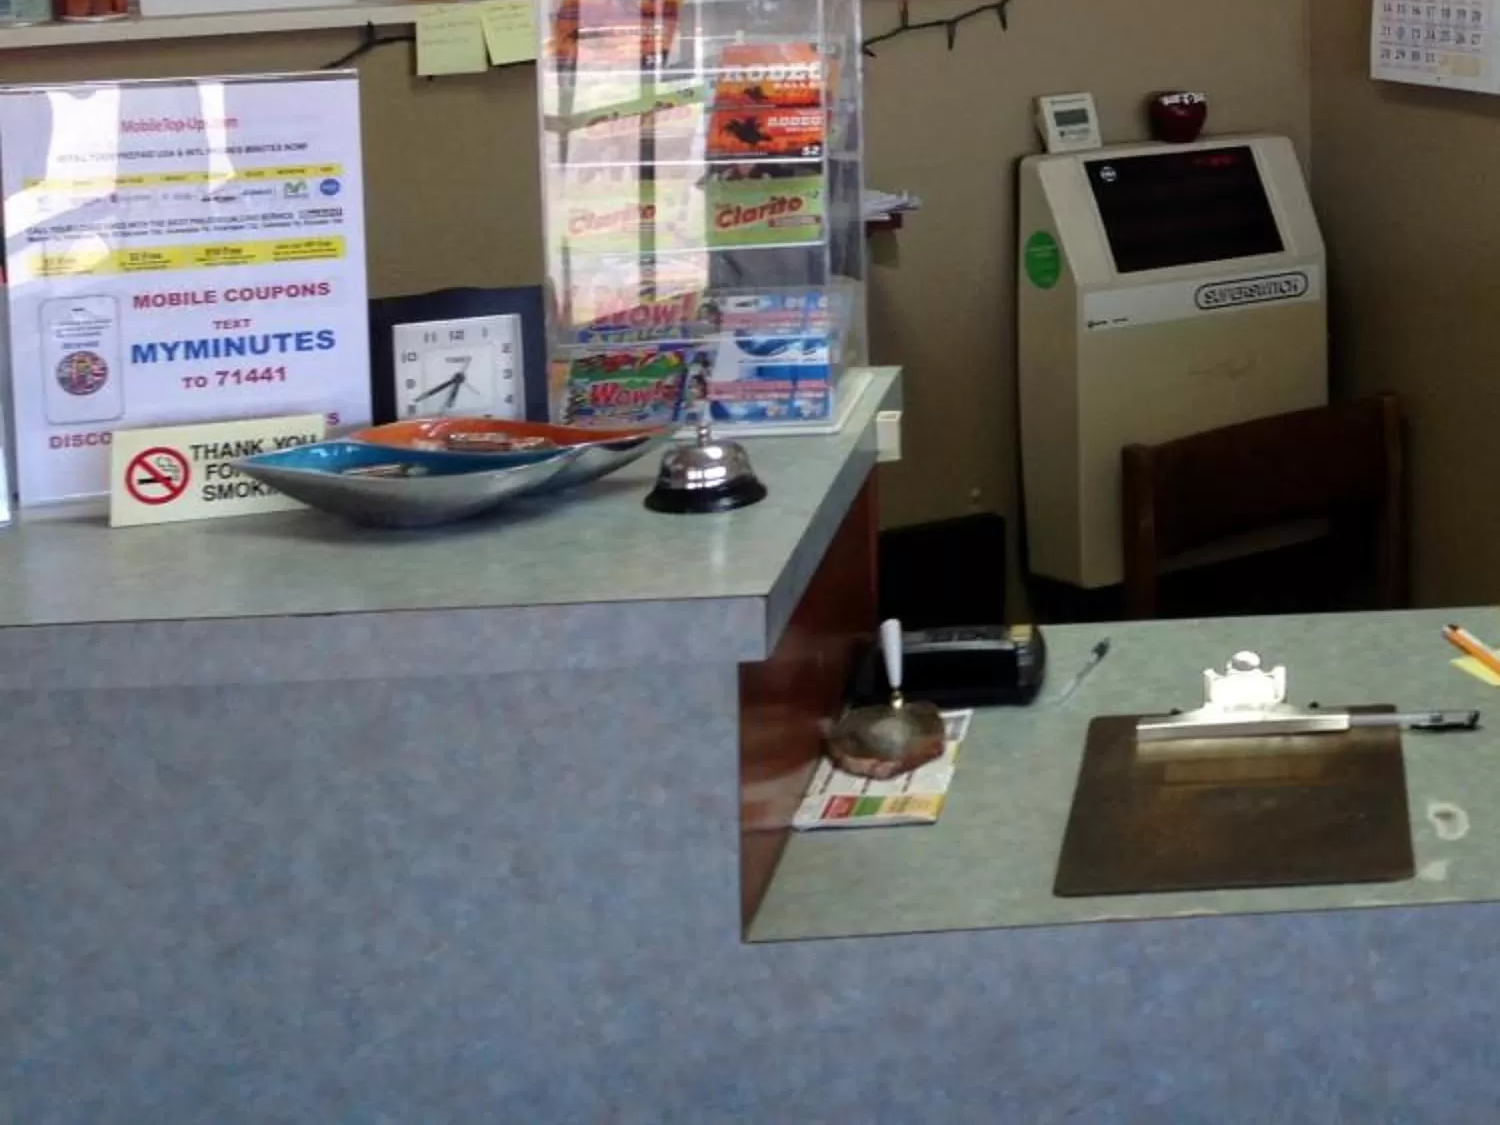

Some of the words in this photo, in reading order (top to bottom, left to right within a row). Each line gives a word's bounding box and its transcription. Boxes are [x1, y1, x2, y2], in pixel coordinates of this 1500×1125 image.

[715, 195, 804, 228] Clarito
[133, 289, 217, 309] MOBILE
[223, 281, 331, 303] COUPONS
[212, 318, 252, 330] TEXT
[131, 329, 336, 364] MYMINUTES
[181, 376, 209, 389] TO
[215, 366, 288, 386] 71441
[49, 431, 113, 450] DISCO
[189, 439, 265, 461] THANK
[202, 482, 281, 502] SMOK
